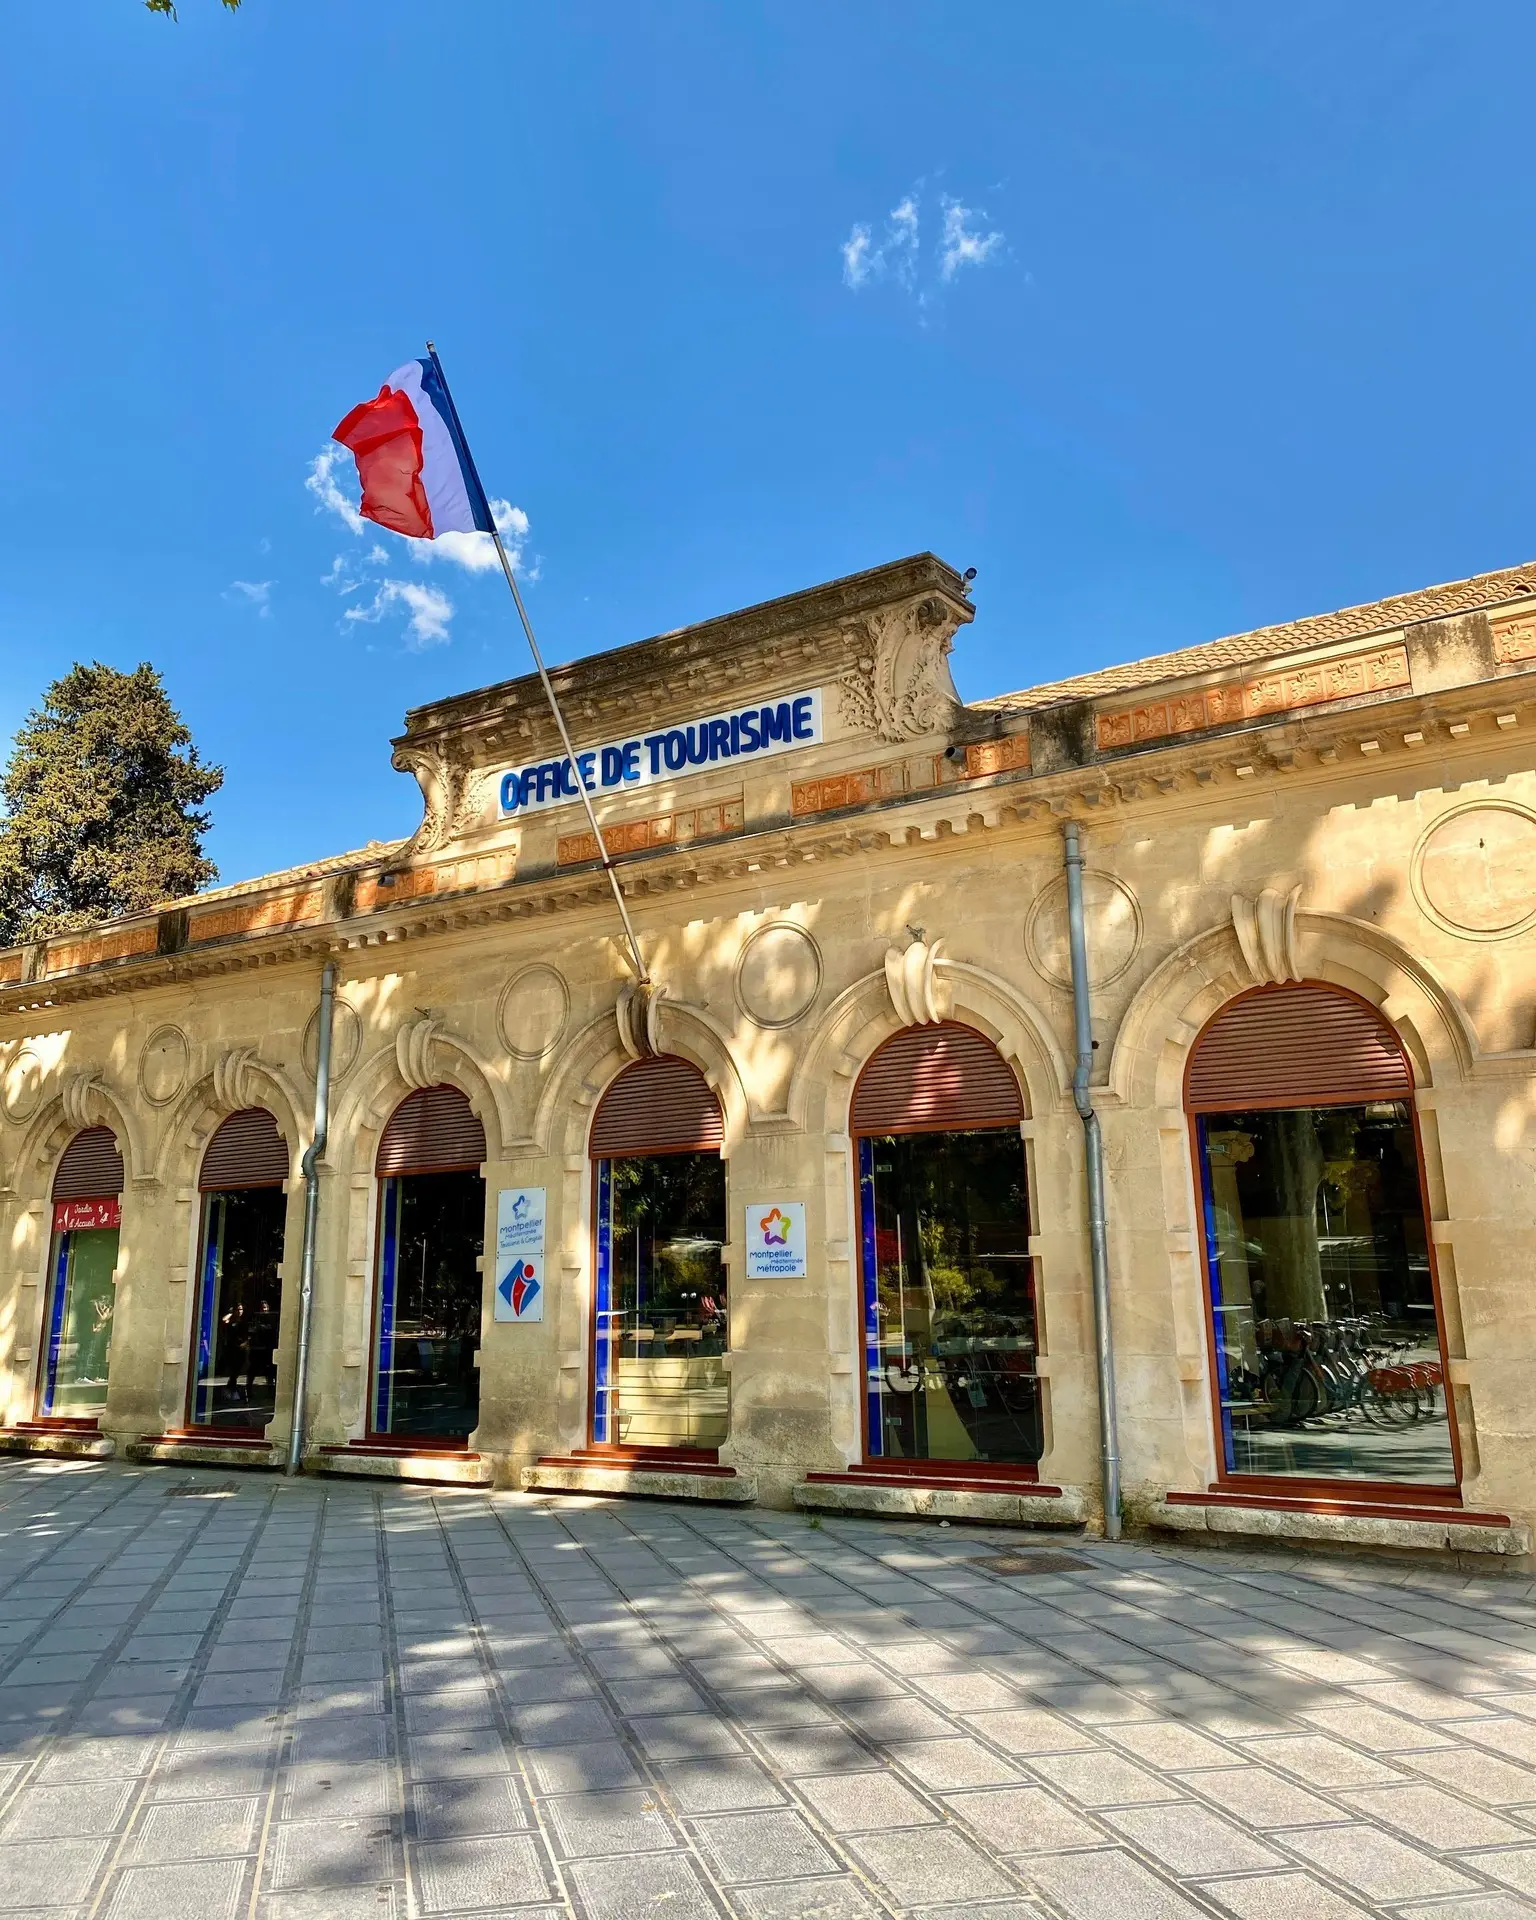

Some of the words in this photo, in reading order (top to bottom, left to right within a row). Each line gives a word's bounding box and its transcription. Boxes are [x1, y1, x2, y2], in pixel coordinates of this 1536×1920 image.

[500, 752, 597, 811] OFFICE
[601, 741, 641, 787] DE
[644, 696, 814, 775] TOURISME
